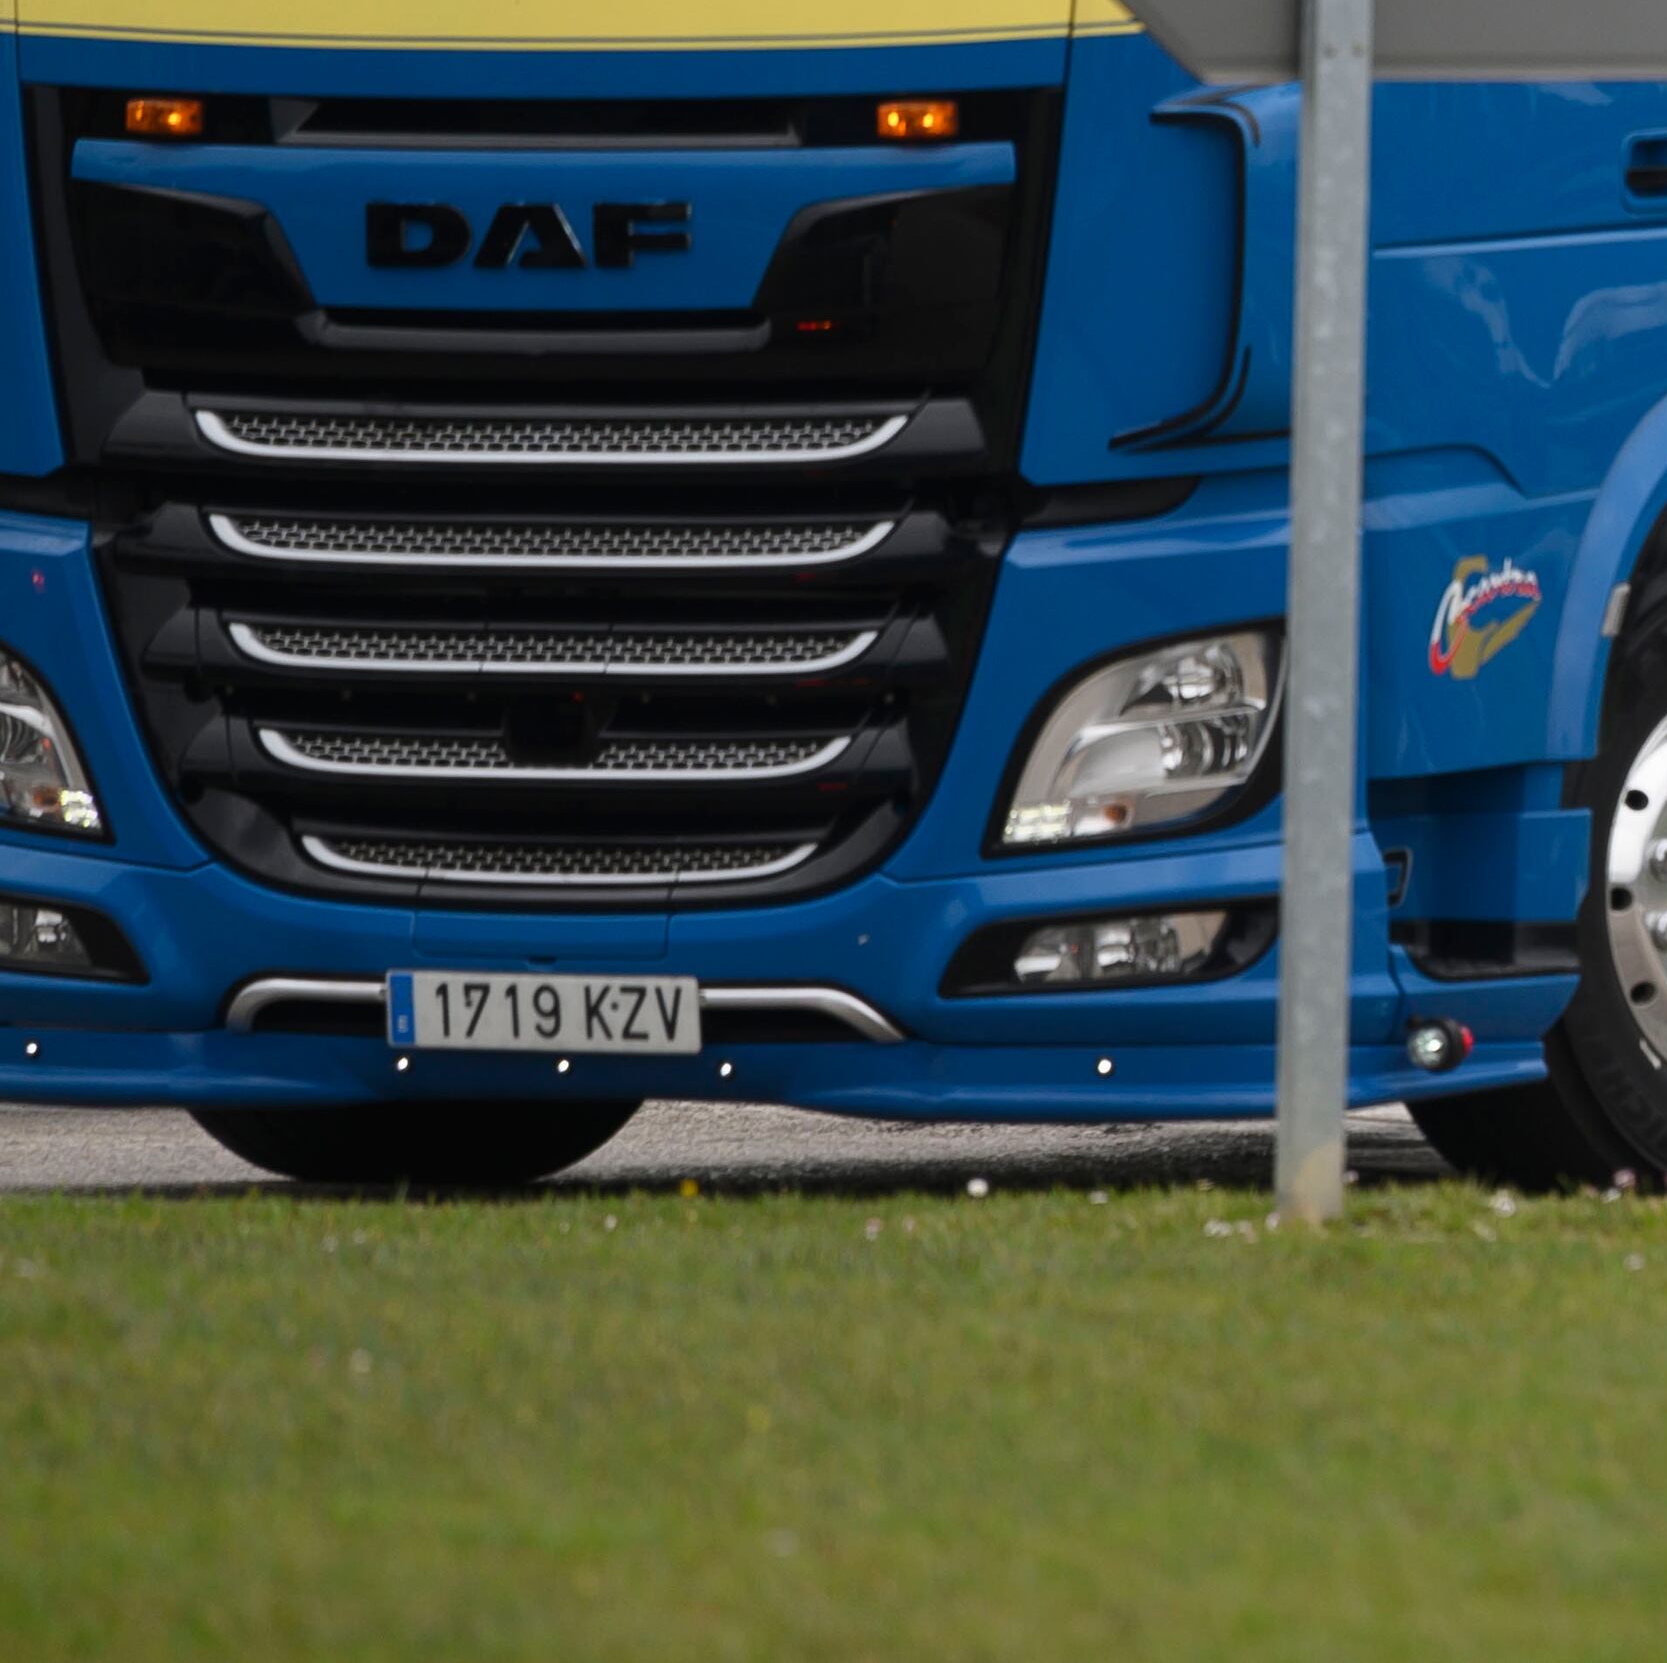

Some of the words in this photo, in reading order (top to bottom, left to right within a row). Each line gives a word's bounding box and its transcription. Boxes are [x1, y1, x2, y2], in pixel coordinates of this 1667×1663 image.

[366, 202, 692, 268] DAF
[435, 982, 562, 1038] 1719
[584, 985, 682, 1041] KZV
